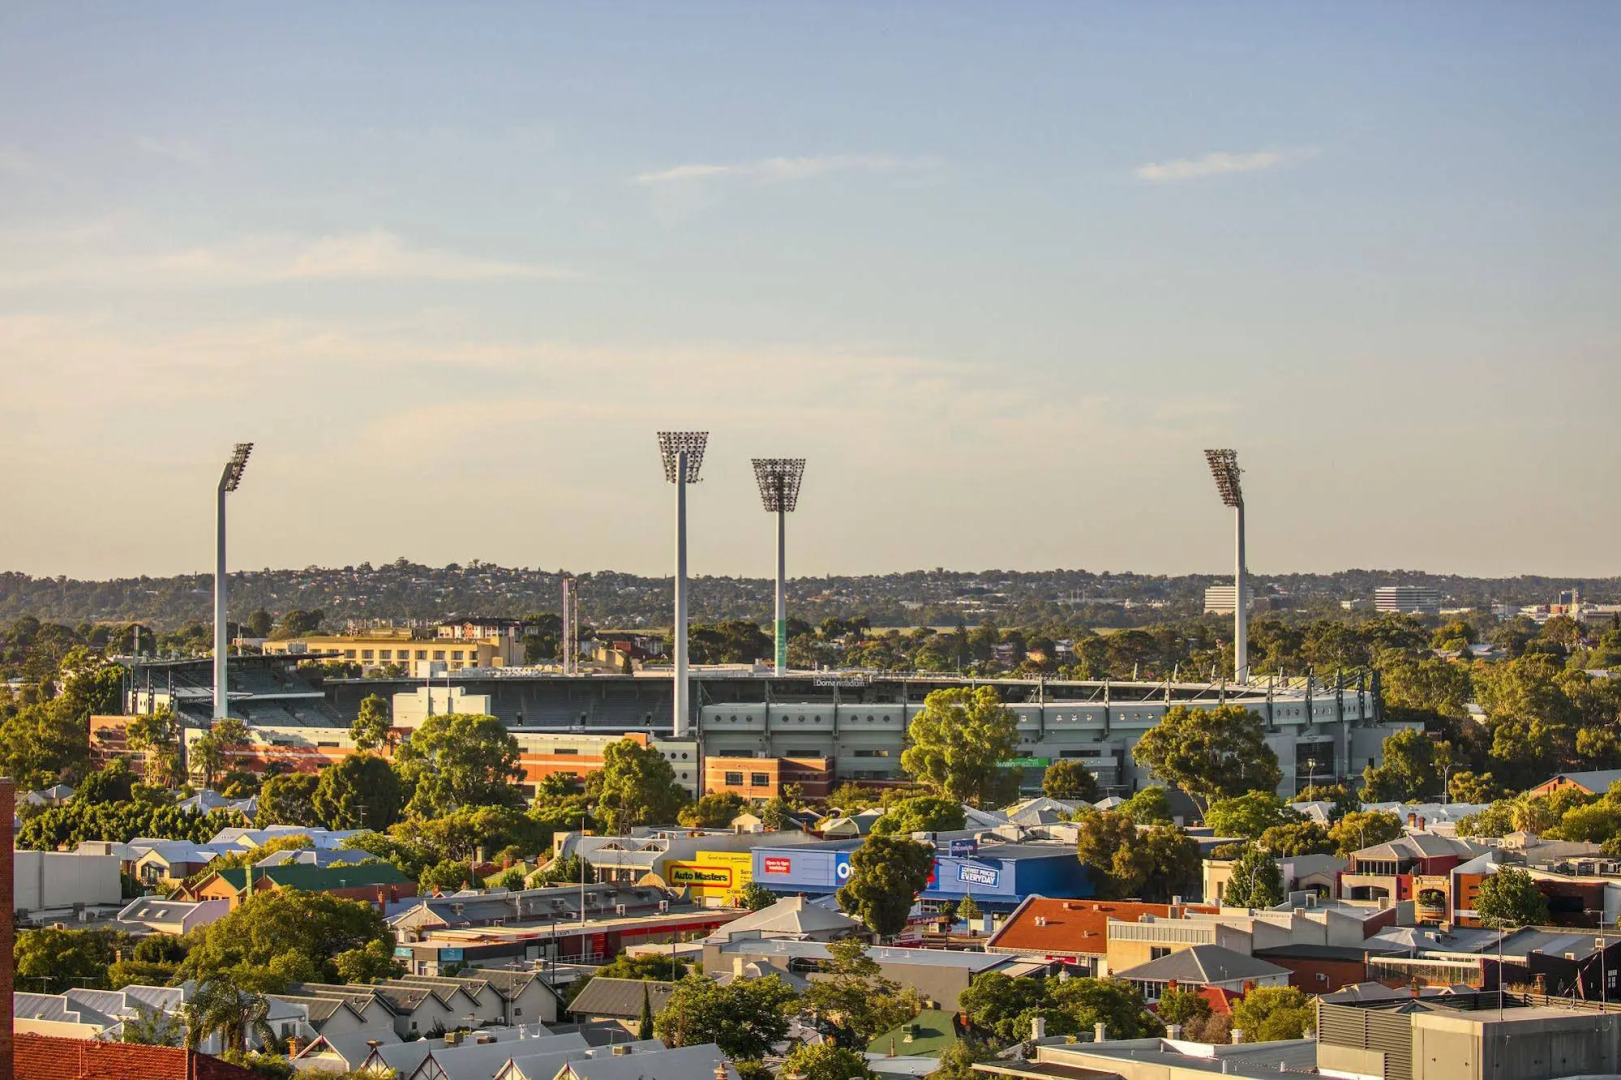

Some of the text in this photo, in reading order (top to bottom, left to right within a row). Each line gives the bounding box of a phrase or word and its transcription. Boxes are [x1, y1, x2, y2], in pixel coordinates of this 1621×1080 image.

[674, 871, 728, 882] Auto Masters
[961, 872, 995, 884] EVERYDAY
